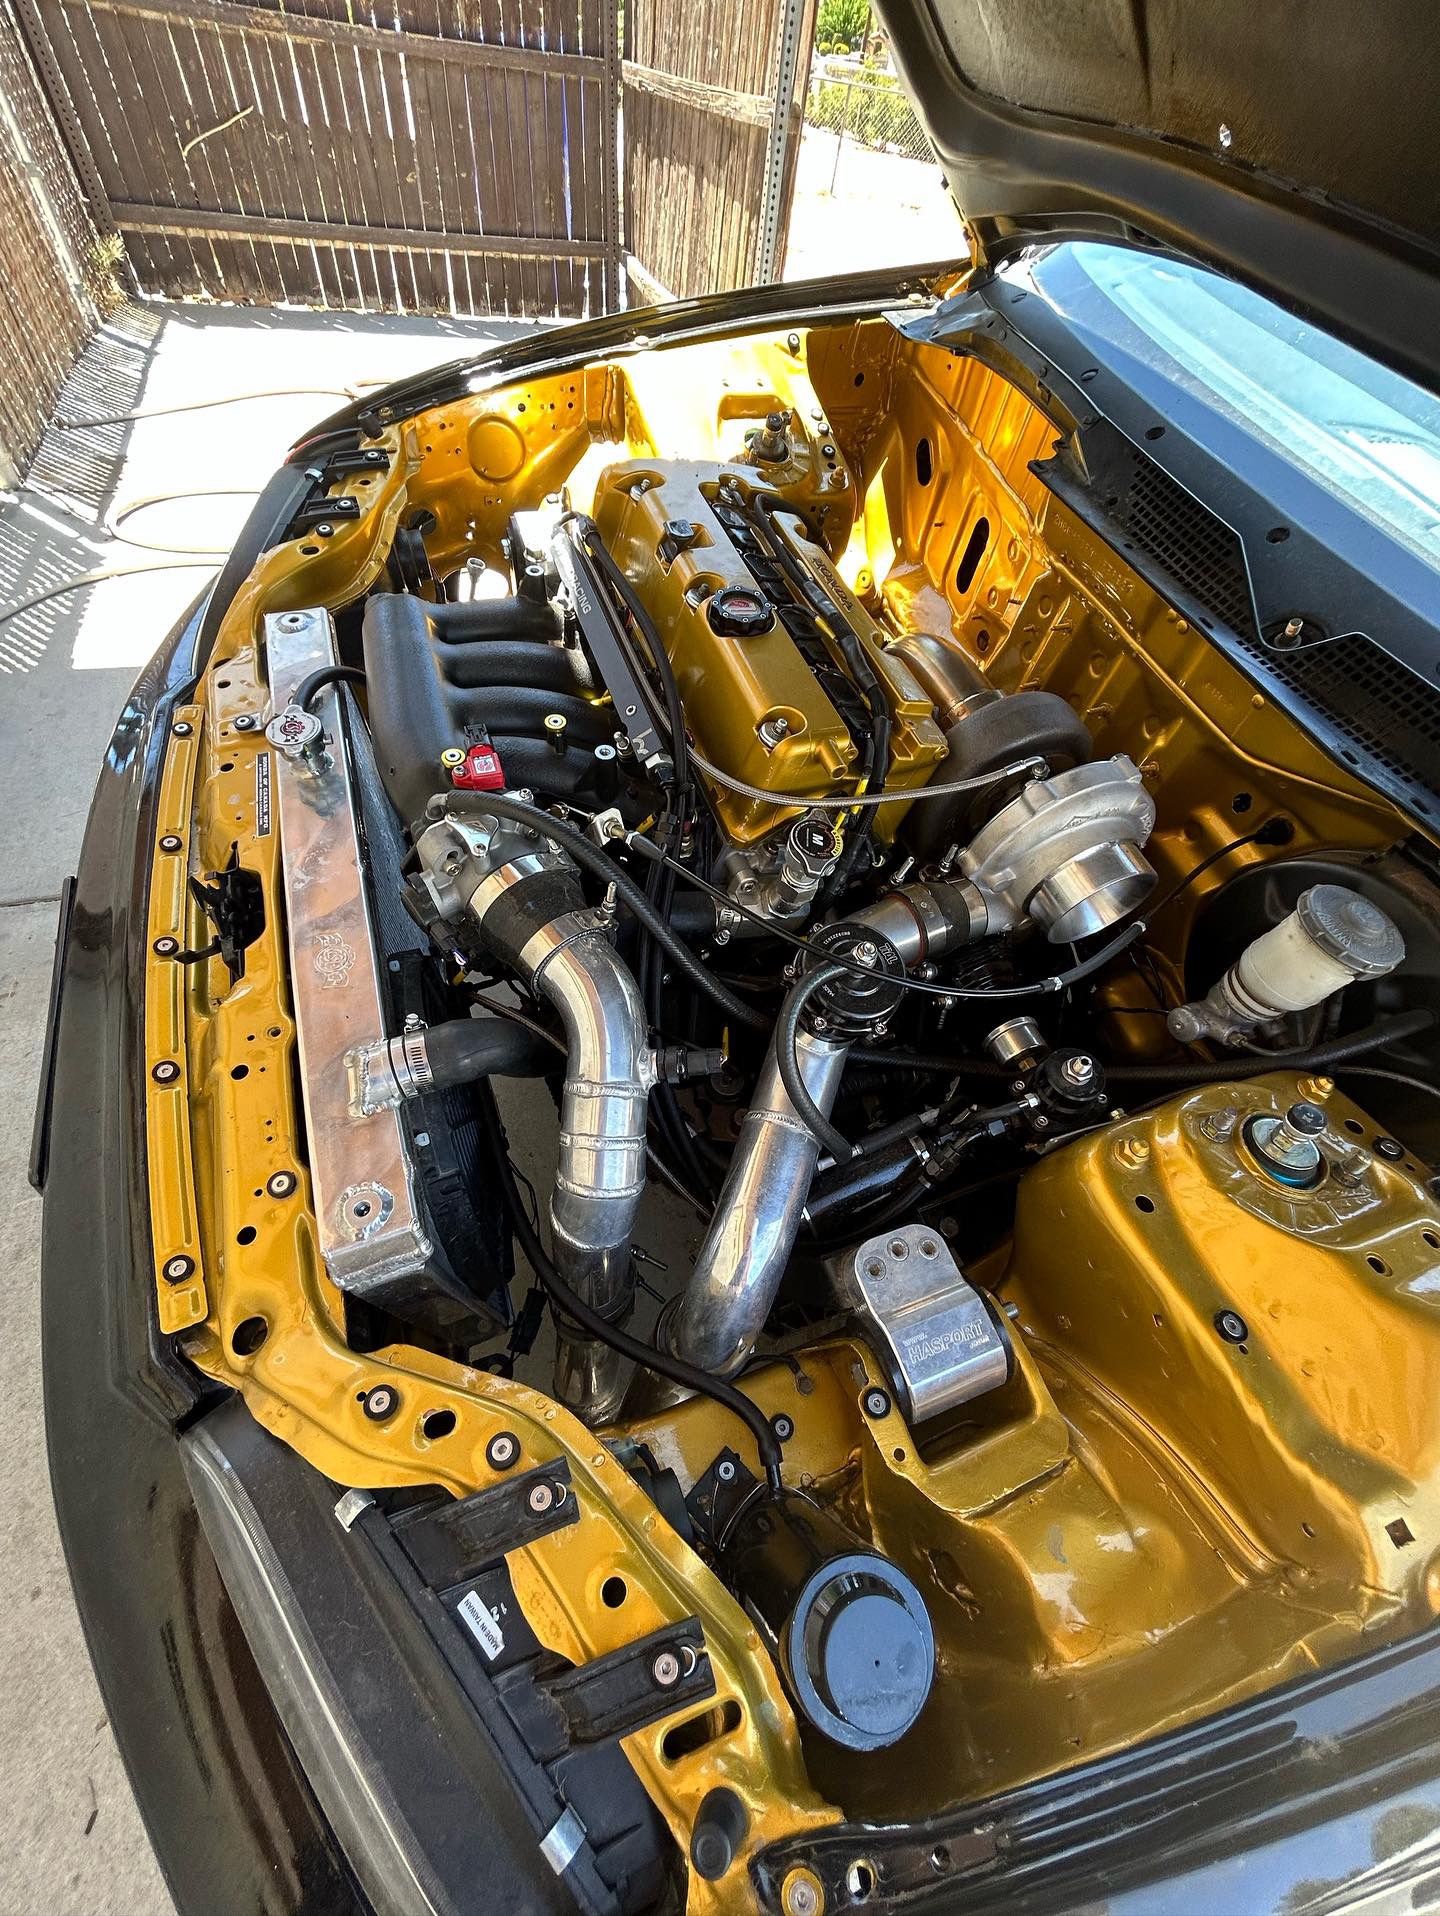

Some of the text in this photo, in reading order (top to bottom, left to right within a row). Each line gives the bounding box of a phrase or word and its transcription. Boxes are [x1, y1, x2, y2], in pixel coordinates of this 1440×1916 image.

[263, 777, 268, 786] OF
[908, 1319, 983, 1365] HASPORT
[463, 1598, 483, 1626] TAIWAN
[479, 1622, 488, 1633] IN
[485, 1630, 500, 1652] MADE
